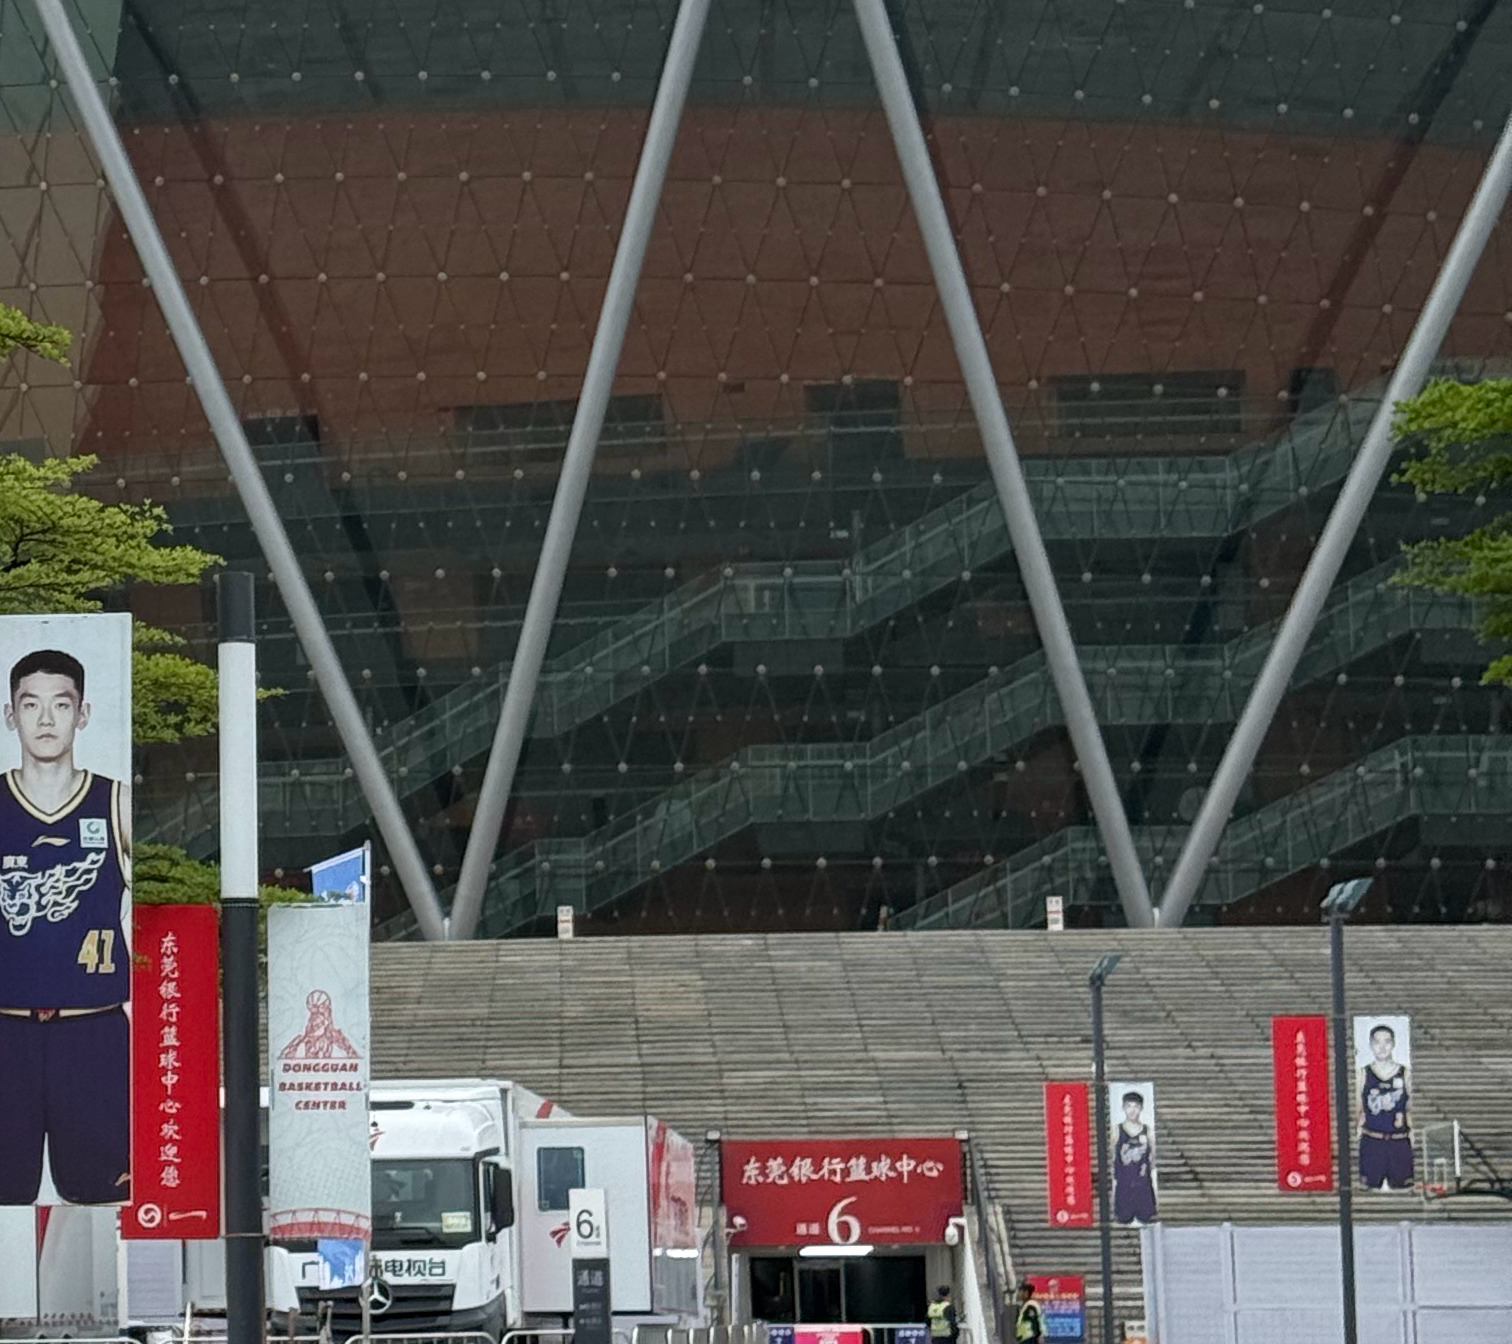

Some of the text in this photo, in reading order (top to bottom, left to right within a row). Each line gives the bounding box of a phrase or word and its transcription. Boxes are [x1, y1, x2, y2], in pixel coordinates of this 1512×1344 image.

[77, 929, 116, 974] 41
[158, 931, 183, 1188] 东莞银行篮球中心欢迎您
[282, 1063, 359, 1073] DONGGUAN
[278, 1081, 363, 1092] BASKETBALL
[294, 1100, 347, 1111] CENTER
[741, 1154, 944, 1185] 东莞银行篮球中心
[576, 1209, 594, 1240] 6
[827, 1196, 861, 1245] 6
